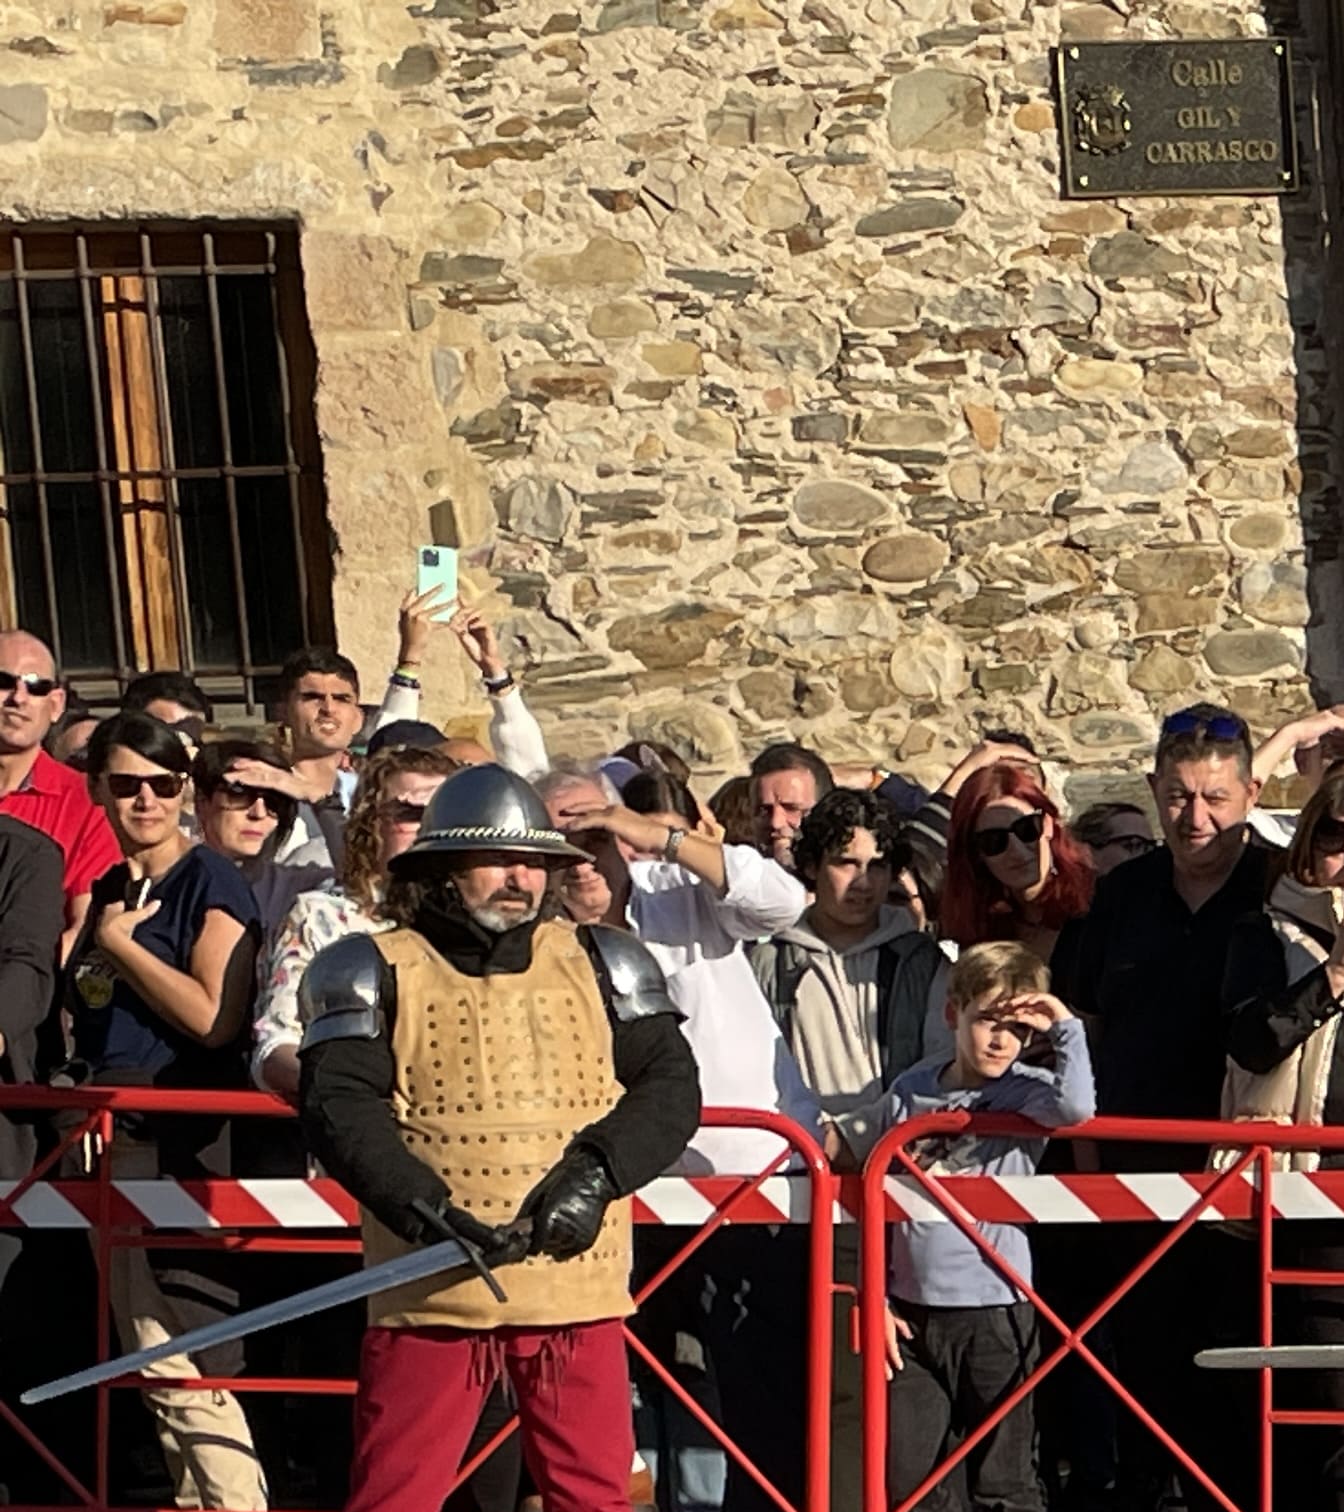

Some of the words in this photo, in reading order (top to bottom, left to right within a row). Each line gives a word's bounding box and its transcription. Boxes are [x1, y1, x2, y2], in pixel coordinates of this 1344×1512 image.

[1171, 60, 1242, 88] Calle
[1177, 107, 1220, 128] GIL
[1226, 106, 1242, 127] Y
[1146, 139, 1278, 164] CARRASCO
